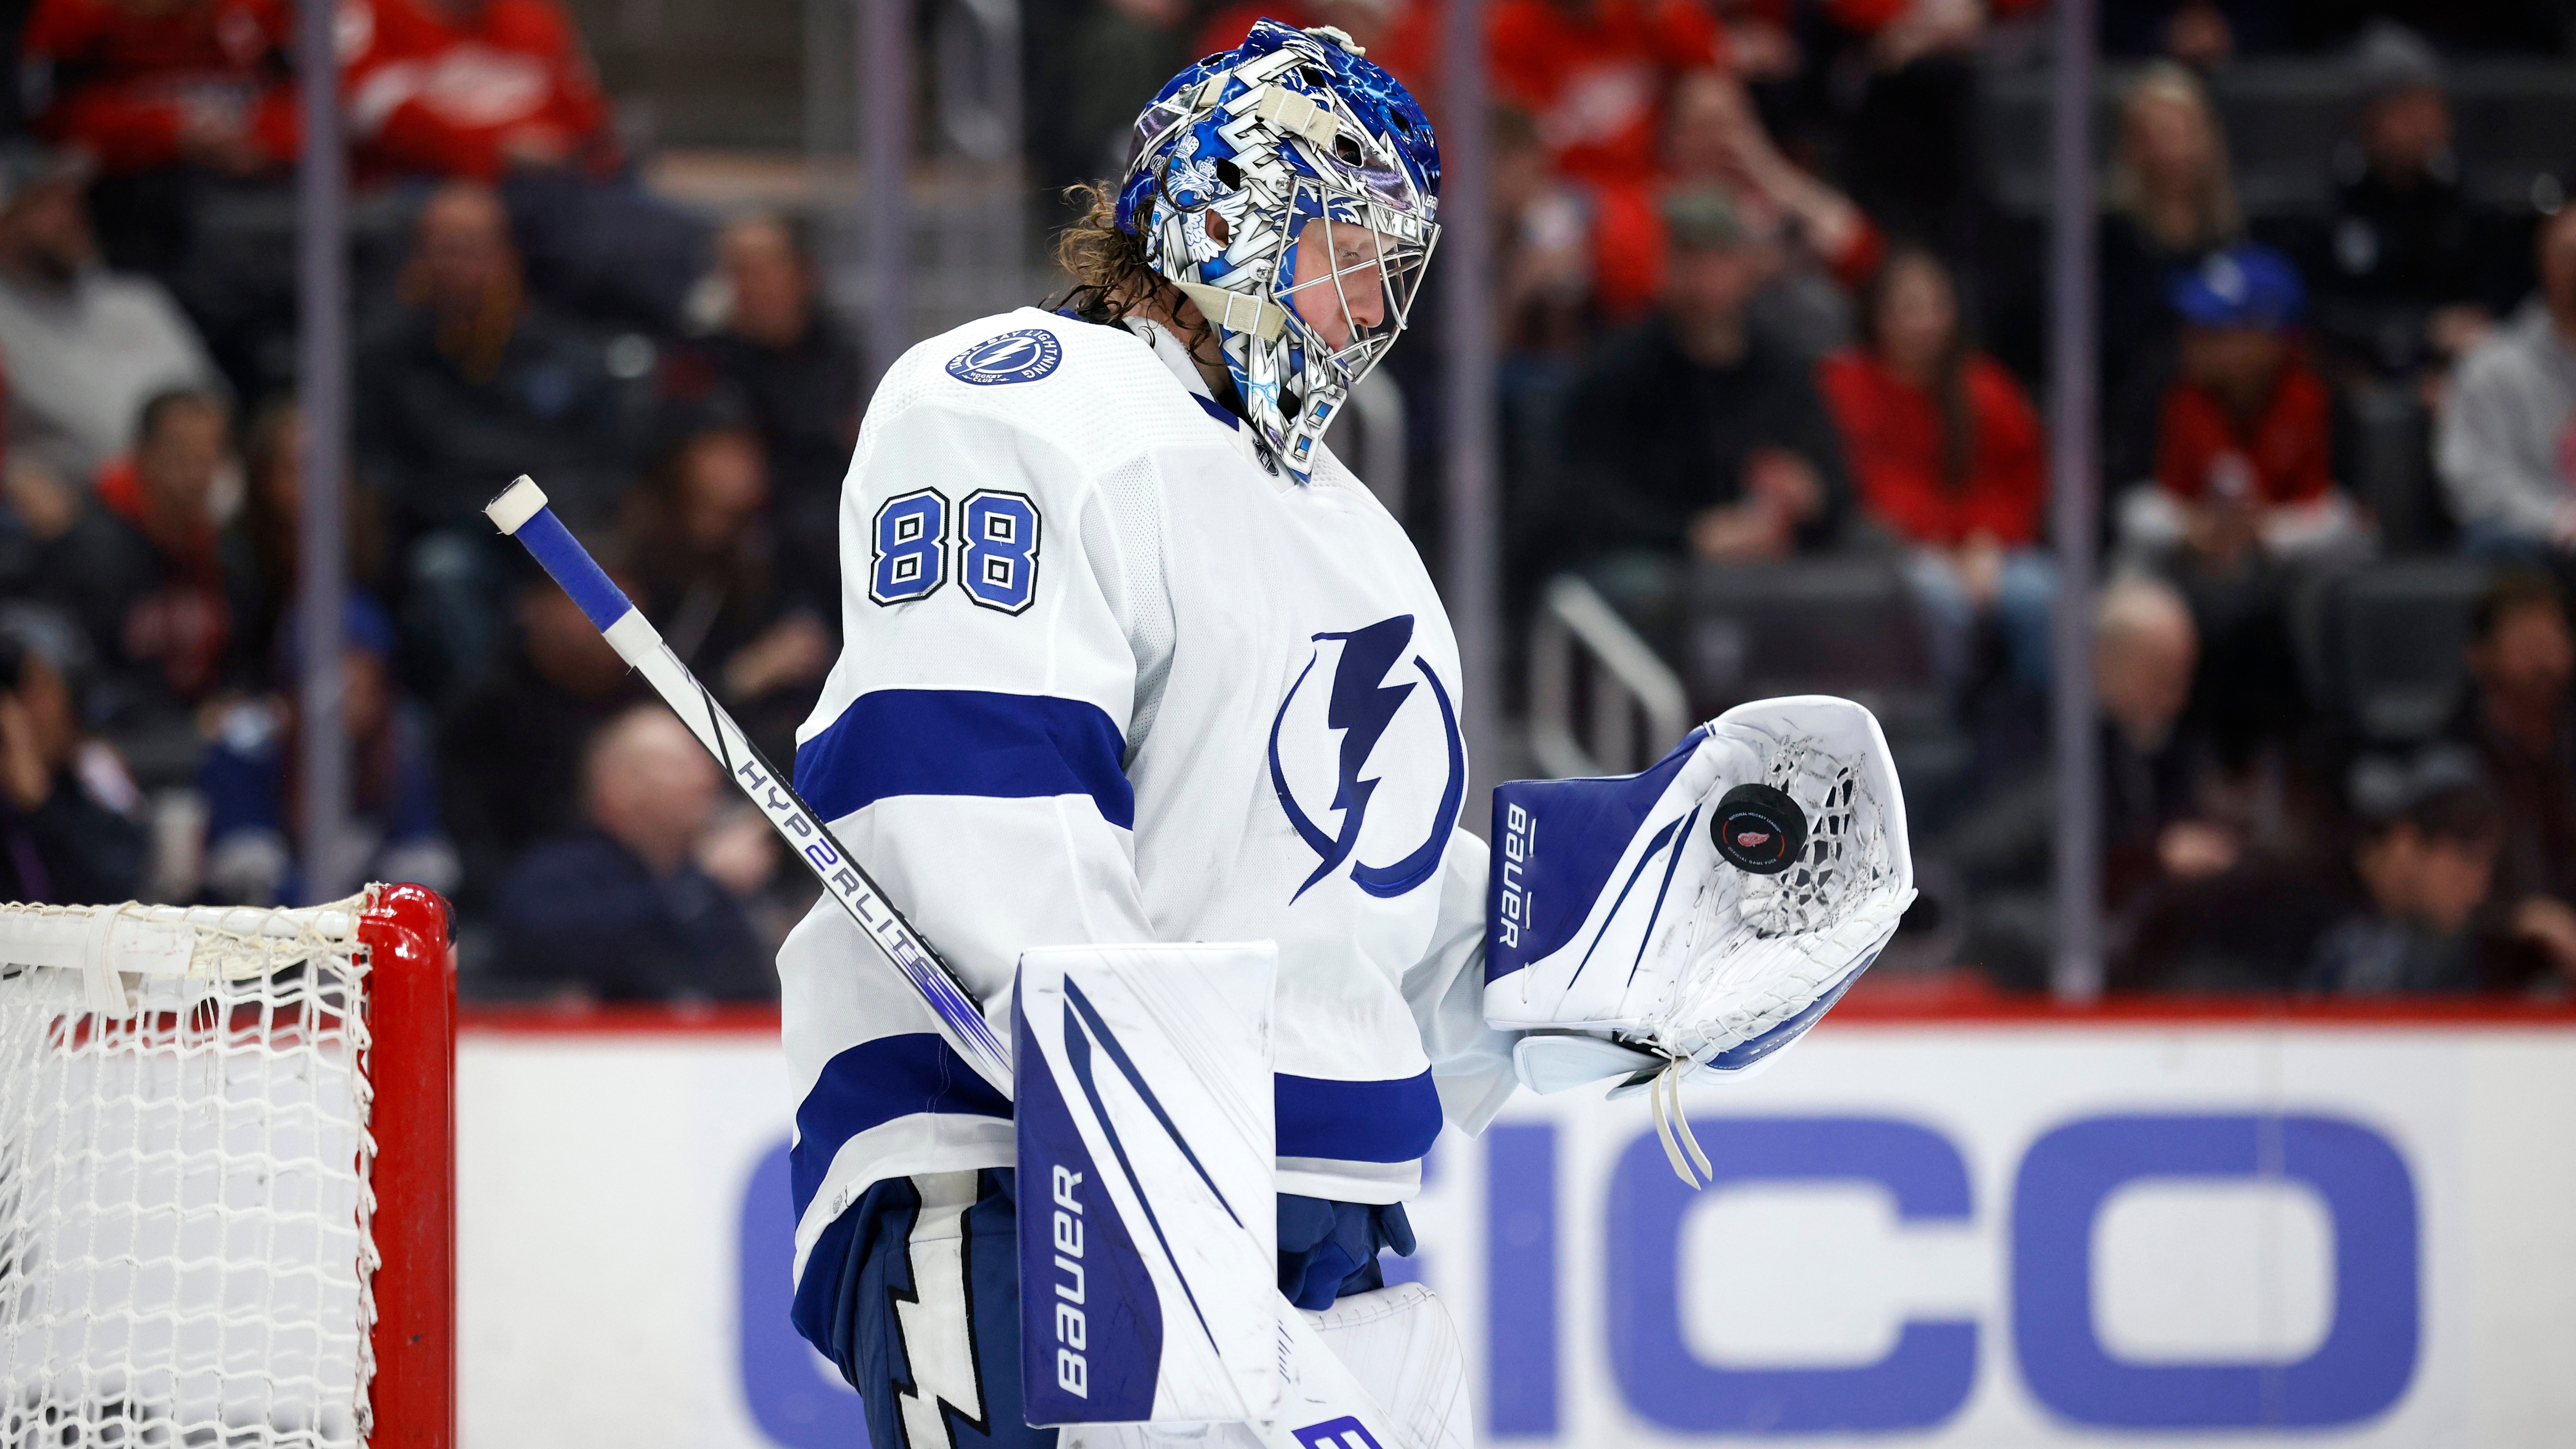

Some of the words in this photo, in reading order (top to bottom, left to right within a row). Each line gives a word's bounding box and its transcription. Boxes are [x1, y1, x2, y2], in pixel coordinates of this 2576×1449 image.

[987, 331, 1022, 344] BAY
[1021, 330, 1058, 378] LIGHTNING
[869, 486, 1042, 617] 88
[737, 761, 938, 984] HYP2RLITE
